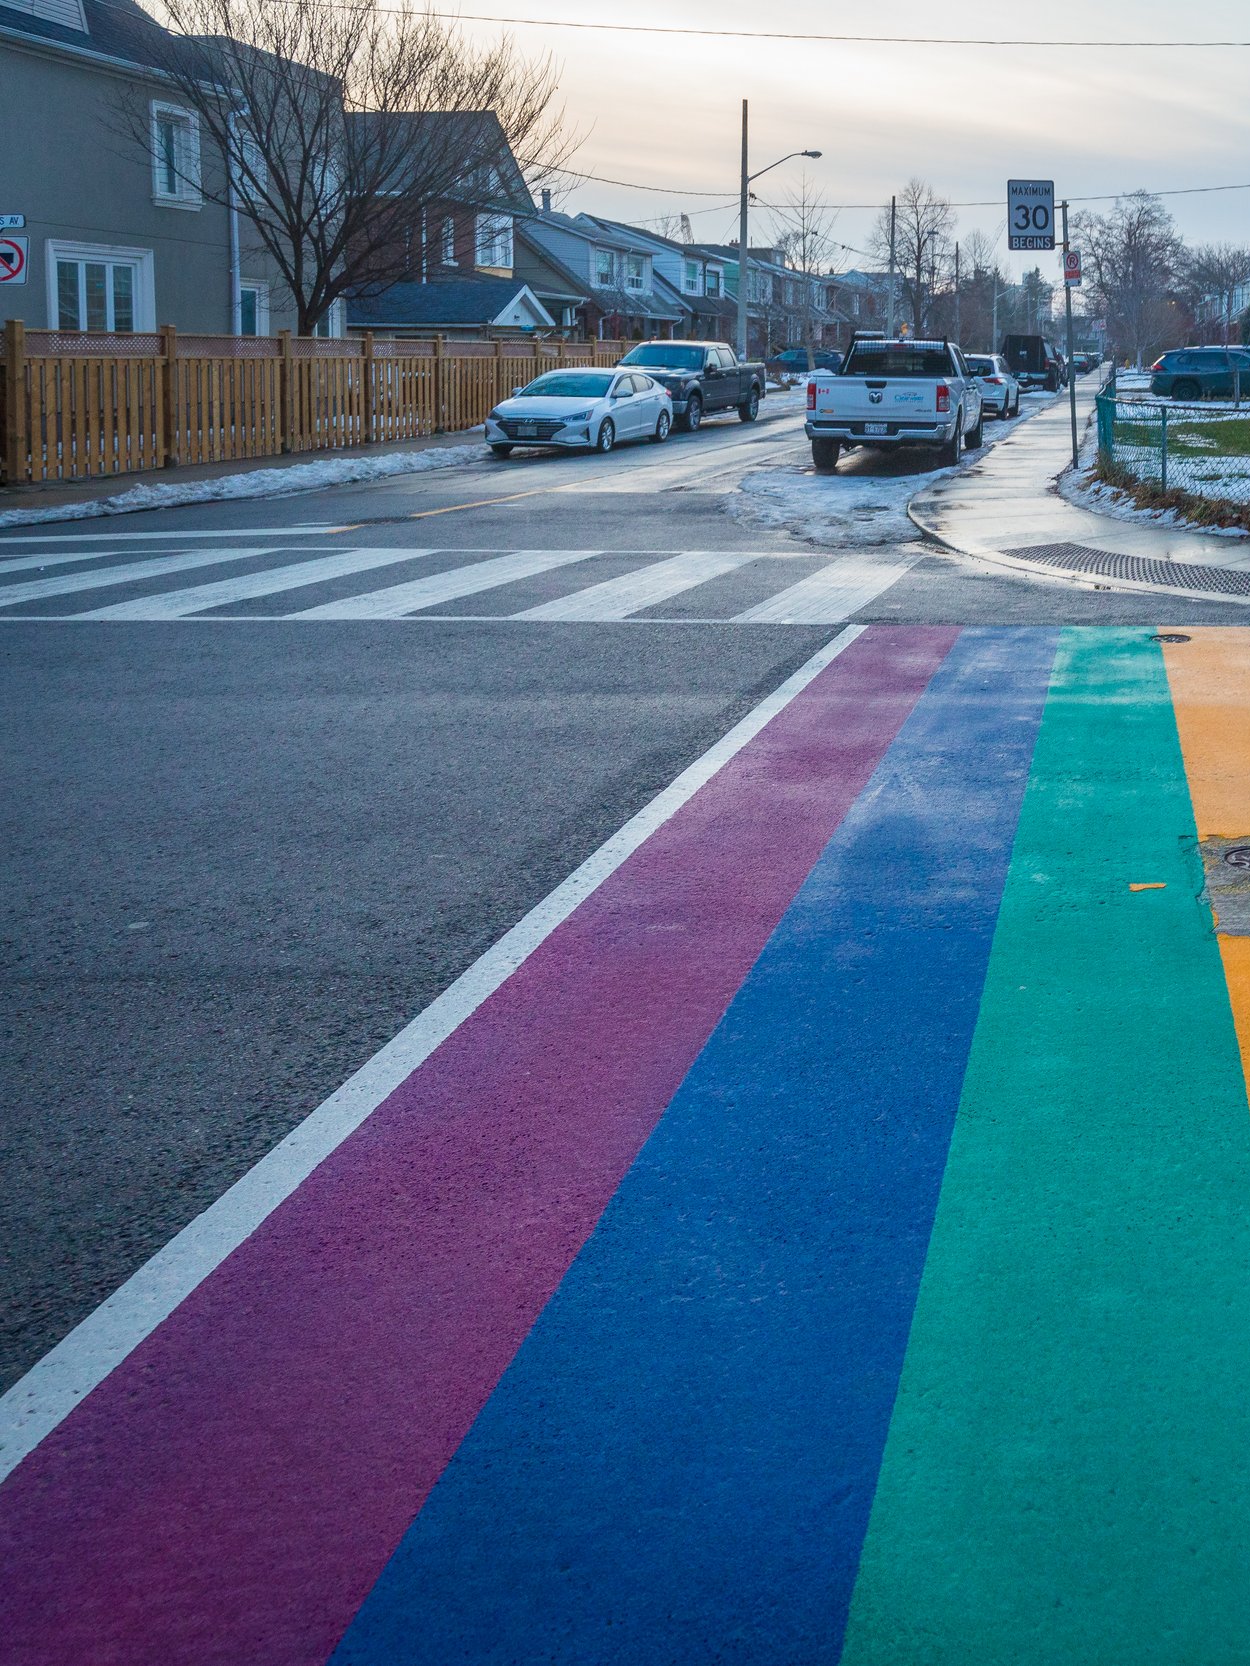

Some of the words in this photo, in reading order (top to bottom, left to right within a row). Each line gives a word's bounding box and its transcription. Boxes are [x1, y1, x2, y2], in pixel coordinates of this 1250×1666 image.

[1011, 186, 1051, 196] MAXIMUM
[1014, 204, 1049, 231] 30
[1012, 237, 1051, 249] BEGINS
